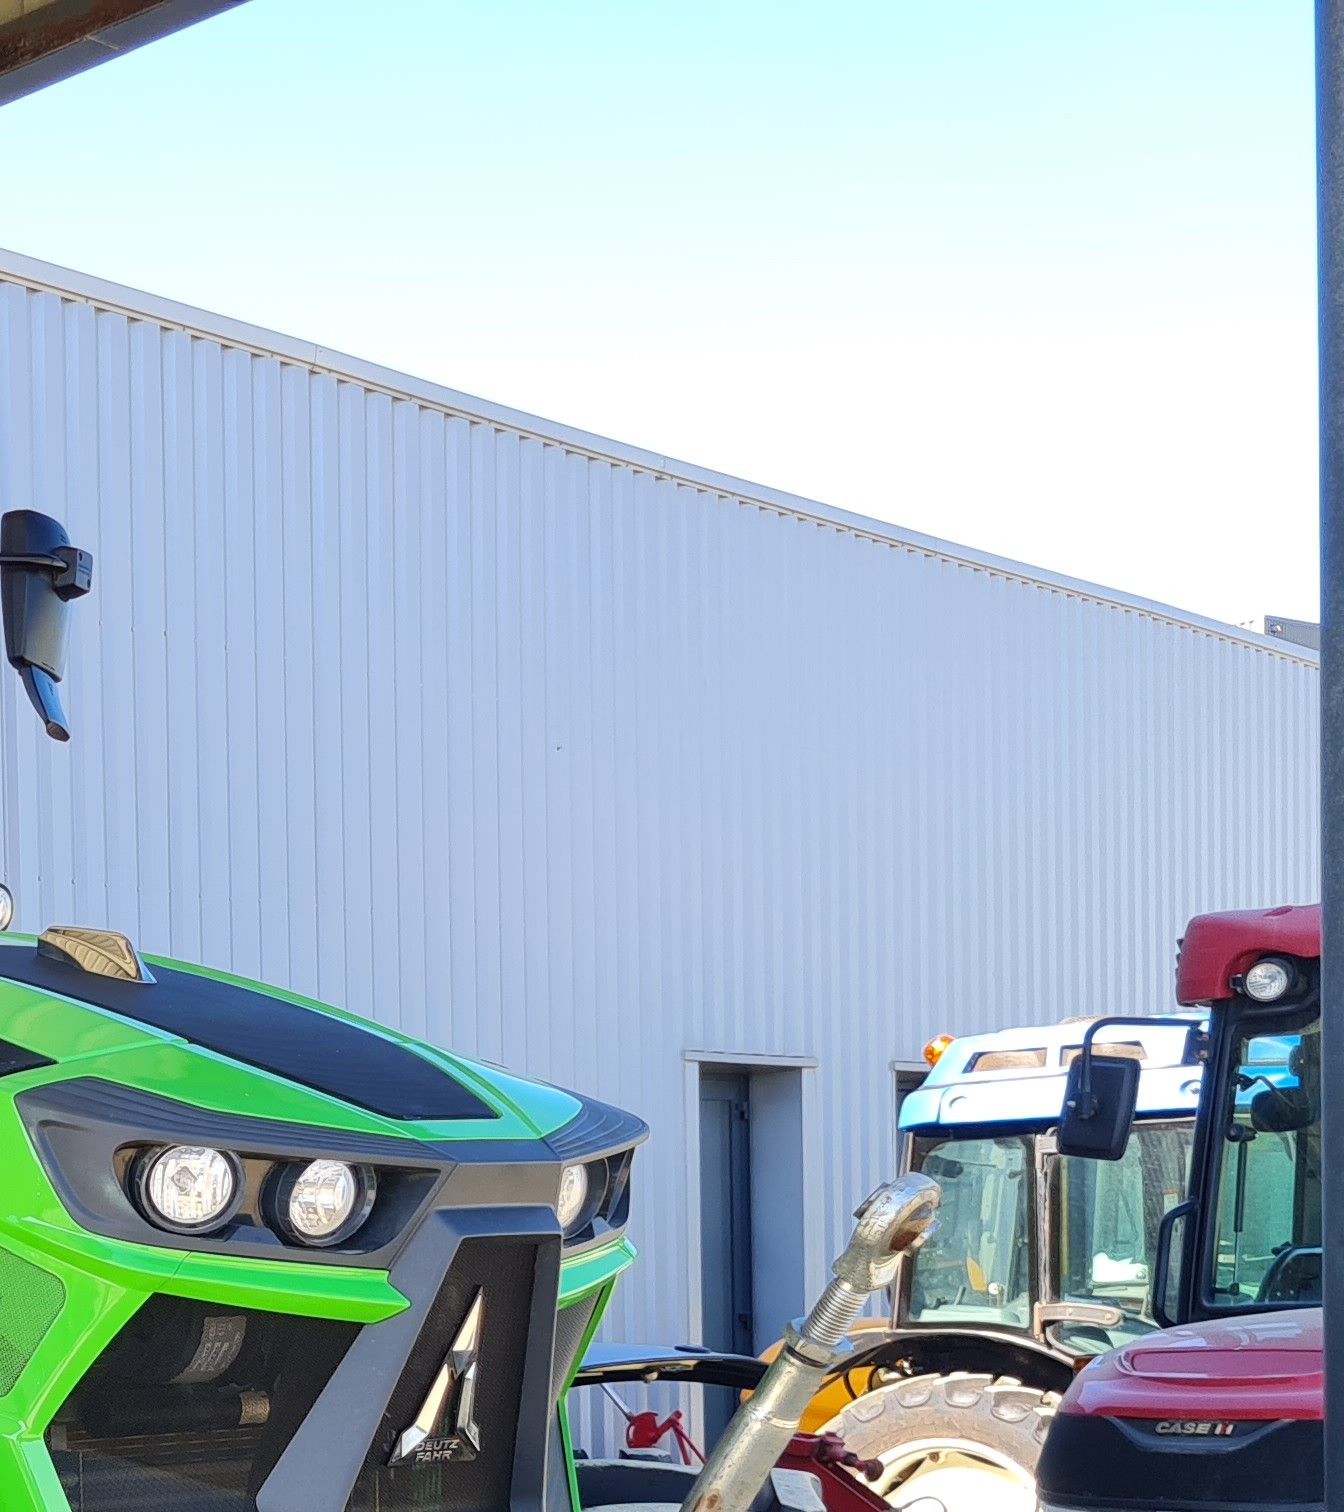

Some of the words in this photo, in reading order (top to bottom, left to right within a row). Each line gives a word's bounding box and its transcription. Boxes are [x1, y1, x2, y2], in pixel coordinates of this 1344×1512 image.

[1155, 1422, 1212, 1434] CASE
[415, 1440, 460, 1451] DEUTZ
[416, 1450, 452, 1462] FAHR
